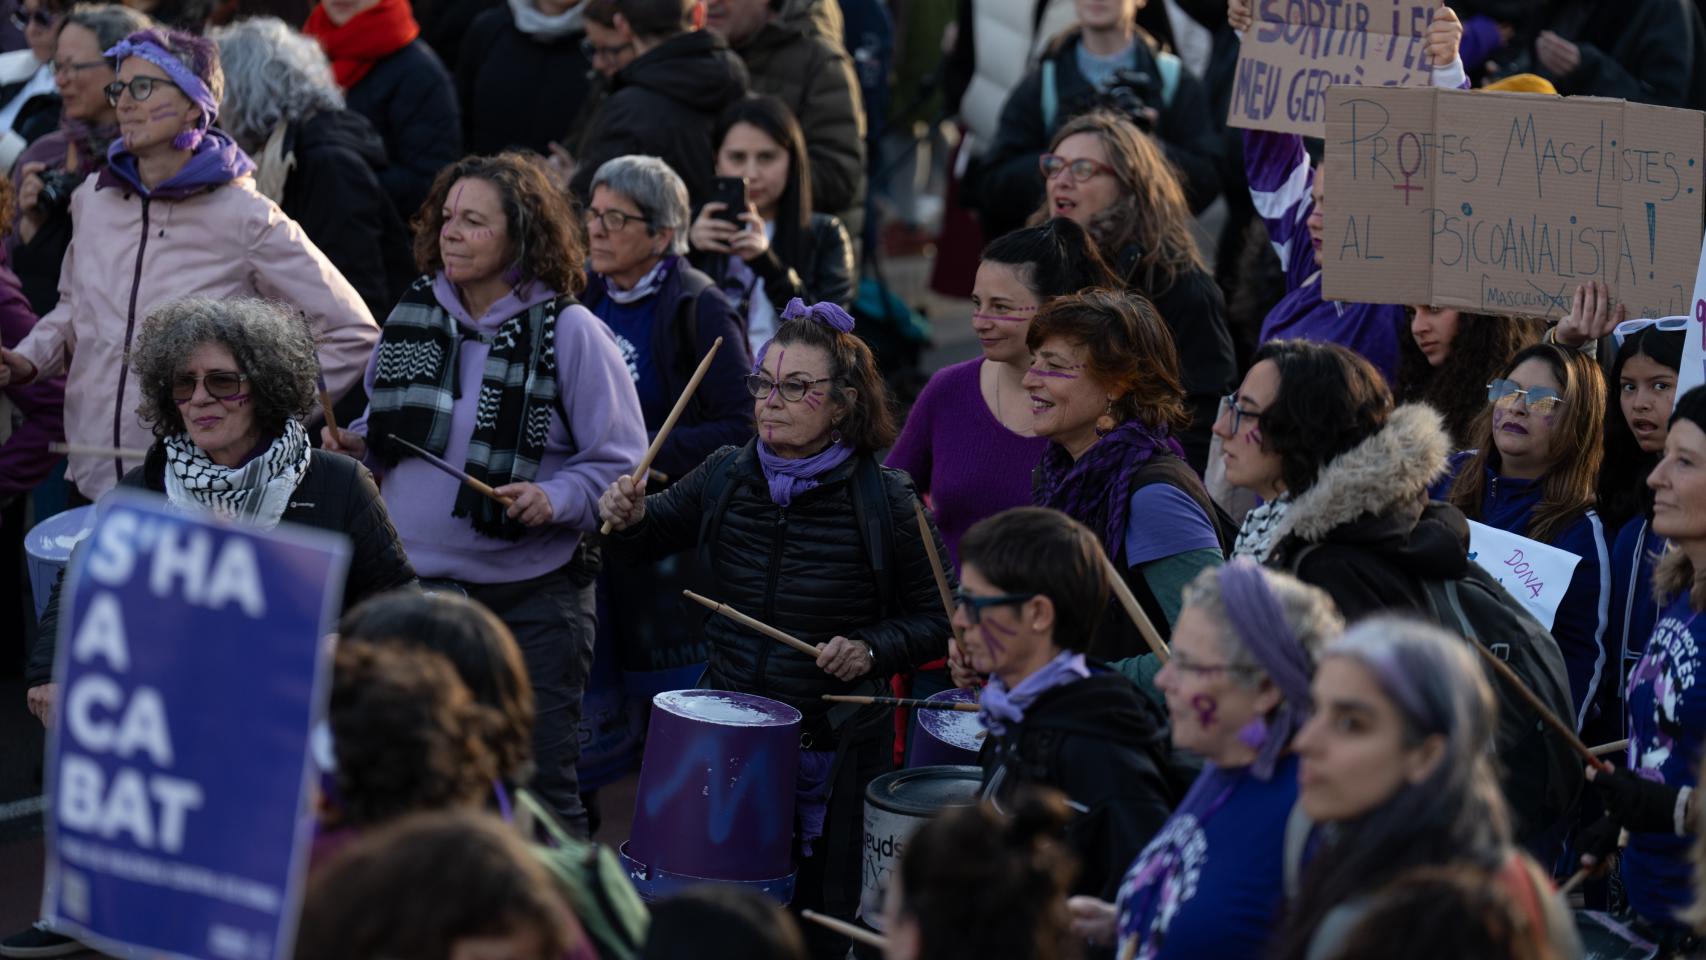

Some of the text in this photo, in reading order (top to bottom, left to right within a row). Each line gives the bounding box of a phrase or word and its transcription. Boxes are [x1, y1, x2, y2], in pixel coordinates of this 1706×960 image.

[1256, 0, 1370, 60] SORTIR
[1233, 57, 1363, 122] MEU GER
[1339, 214, 1385, 260] AL
[88, 511, 266, 619] S'HA
[1503, 549, 1544, 600] DONA
[73, 592, 131, 673] A
[66, 674, 173, 768] CA
[58, 754, 204, 853] BAT
